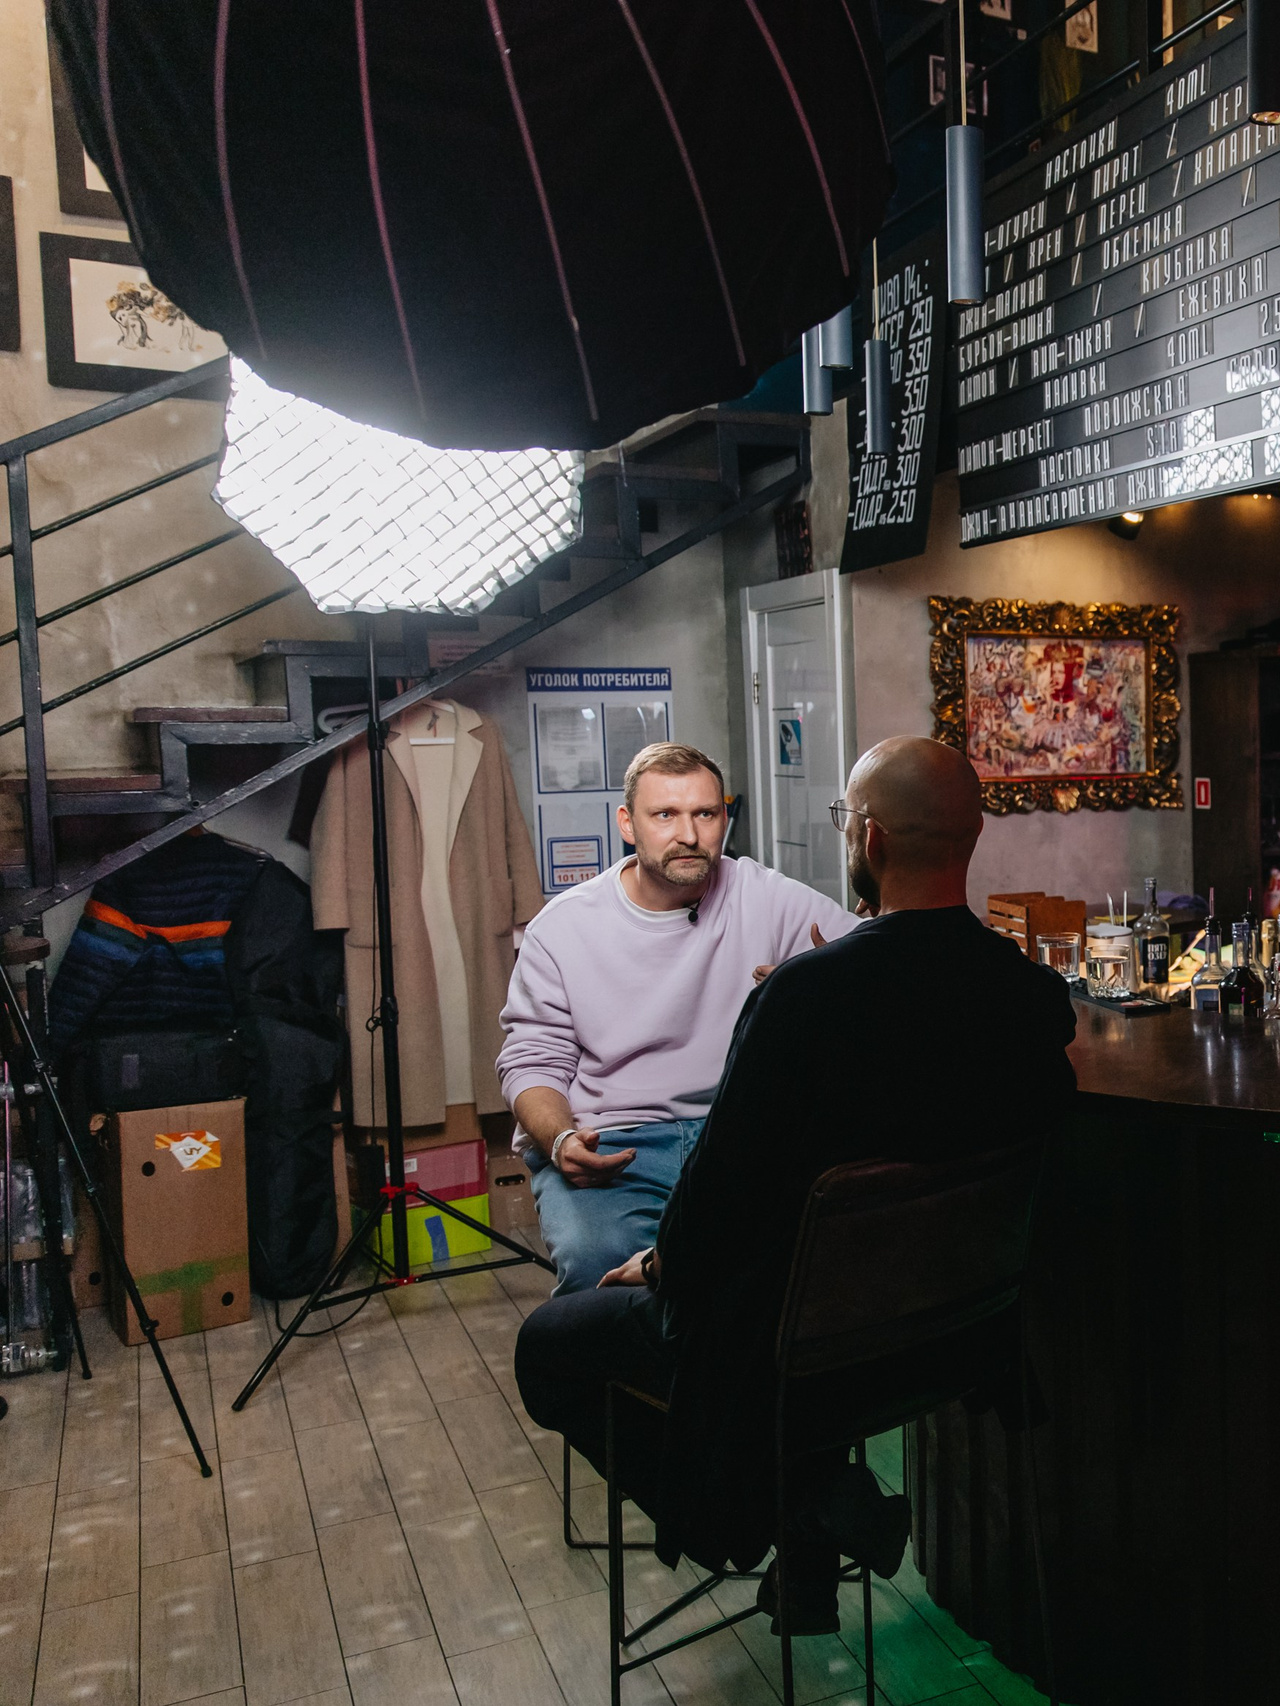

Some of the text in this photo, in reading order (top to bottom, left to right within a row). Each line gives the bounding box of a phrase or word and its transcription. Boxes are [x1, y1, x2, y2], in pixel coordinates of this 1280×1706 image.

[1094, 146, 1139, 199] ПИРАТ
[1029, 229, 1061, 269] ХРЕН
[1100, 182, 1146, 235] ПЕРЕЦ
[959, 274, 1044, 339] ДЖИН-МАЛИНА
[1103, 204, 1183, 270] ОБЛЕПИХА
[909, 296, 933, 340] 250
[960, 306, 1052, 372] БУРБОН-ВИШНЯ
[1142, 227, 1229, 294] КЛУБНИКА
[959, 368, 995, 407] ЛИМОН
[1179, 258, 1262, 322] ЕЖЕВИКА
[905, 336, 931, 378] 350
[901, 375, 928, 416] 350
[1044, 362, 1106, 409] НАЛИВКИ
[897, 413, 925, 453] 300
[959, 419, 1051, 475] ЛИМОН-ЩЕРБЕТ
[1085, 376, 1186, 437] ПОВОЛЖСКАЯ
[893, 452, 920, 489] 300
[887, 489, 916, 523] 250
[529, 672, 669, 688] УГОЛОК ПОТРЕБИТЕЛЯ
